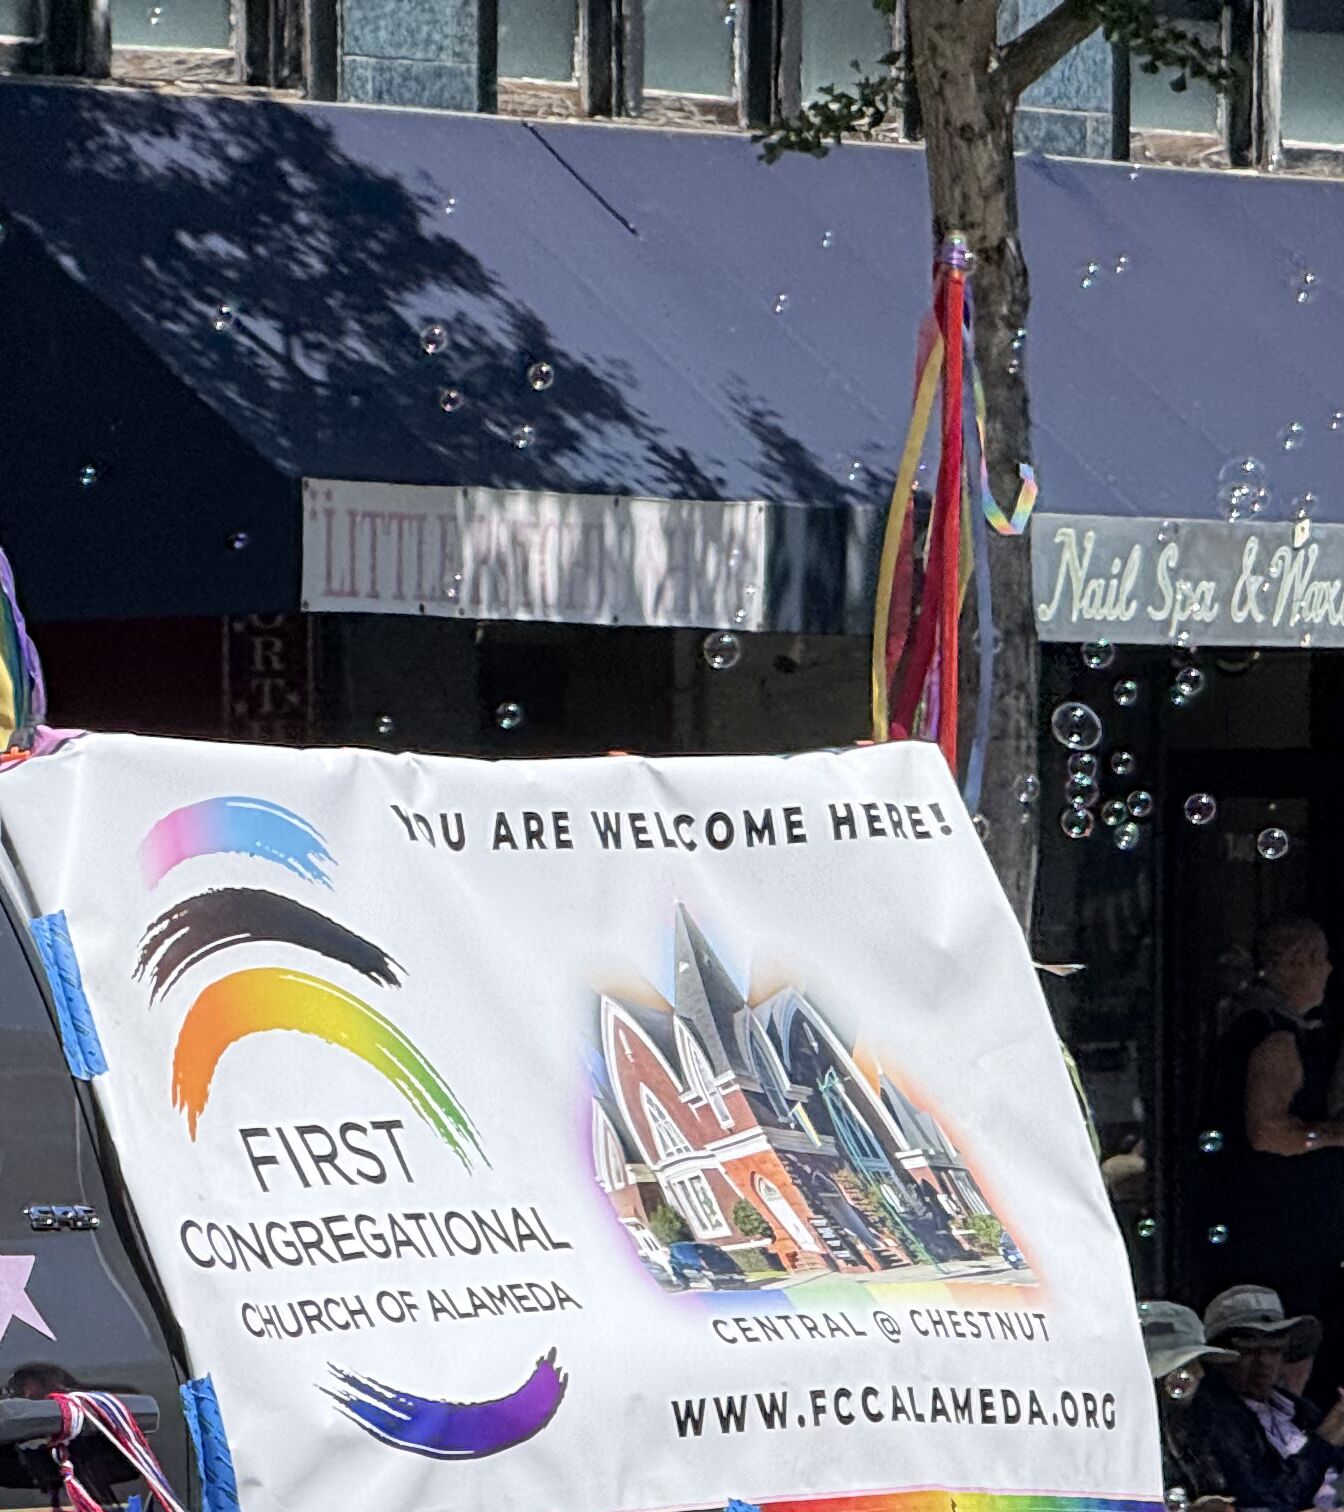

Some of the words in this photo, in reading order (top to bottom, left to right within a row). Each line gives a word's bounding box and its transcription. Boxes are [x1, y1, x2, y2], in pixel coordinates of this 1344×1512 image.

[1038, 527, 1142, 623] Nail
[1146, 542, 1220, 638] Spa
[1230, 535, 1268, 624] &
[1269, 543, 1344, 627] Wax
[491, 810, 574, 851] ARE
[590, 806, 808, 853] WELCOME
[827, 801, 953, 842] HERE!
[238, 1119, 415, 1193] FIRST
[179, 1206, 574, 1273] CONGREGATIONAL
[240, 1294, 376, 1340] CHURCH
[375, 1289, 422, 1325] OF
[429, 1280, 584, 1322] ALAMEDA
[712, 1310, 868, 1345] CENTRAL
[872, 1309, 903, 1344] @
[910, 1309, 1052, 1343] CHESTNUT
[671, 1384, 1118, 1439] WWW.FCCALAMEDA.ORG
